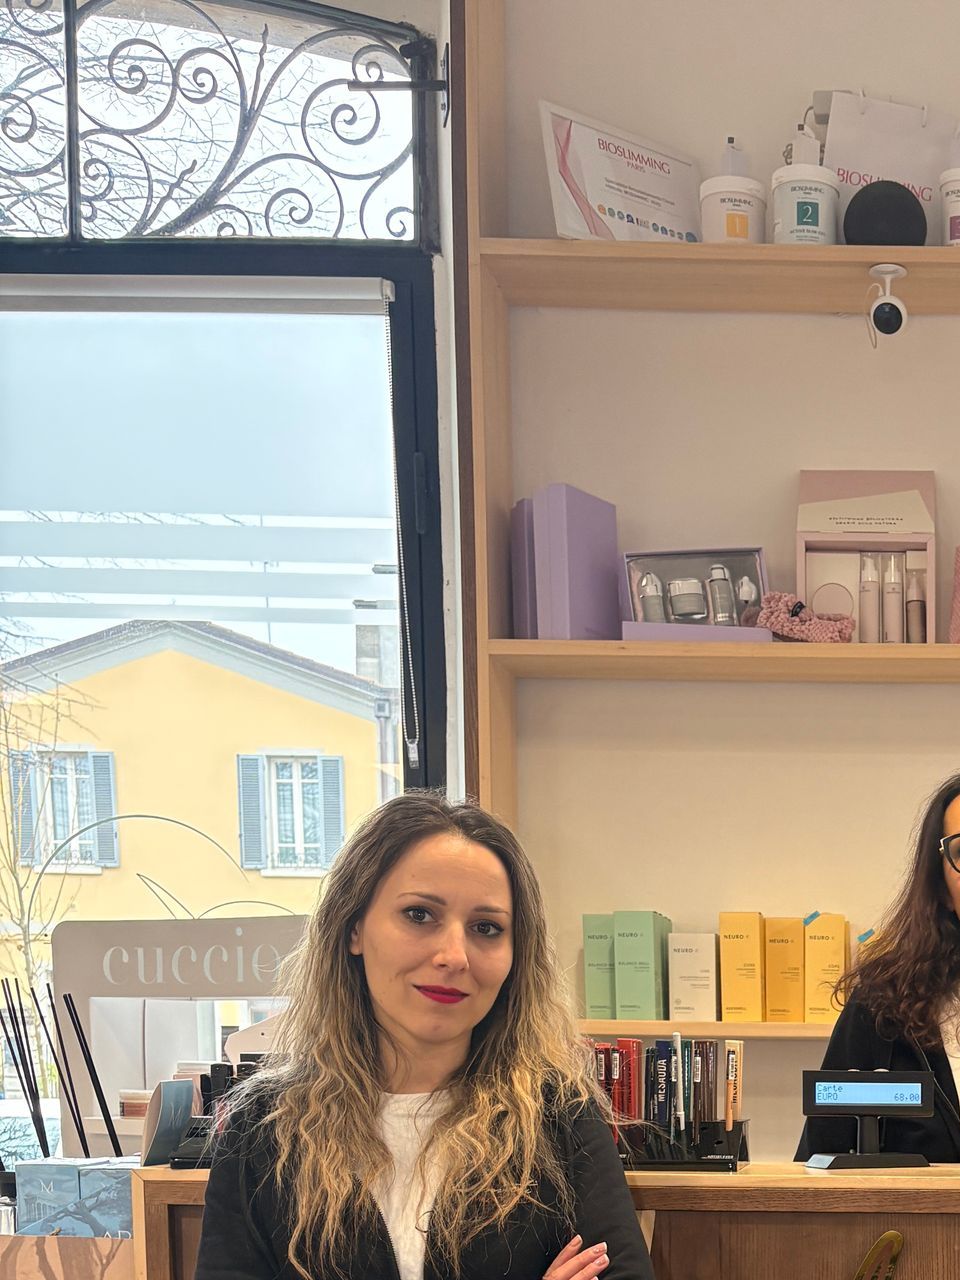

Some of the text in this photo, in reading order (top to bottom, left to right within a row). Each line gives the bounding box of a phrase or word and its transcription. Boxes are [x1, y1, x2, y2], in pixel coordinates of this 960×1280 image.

[597, 137, 671, 175] BIOSLIMMING
[802, 205, 813, 222] 2
[657, 1058, 668, 1102] MESAUDA
[816, 1092, 839, 1101] EURO
